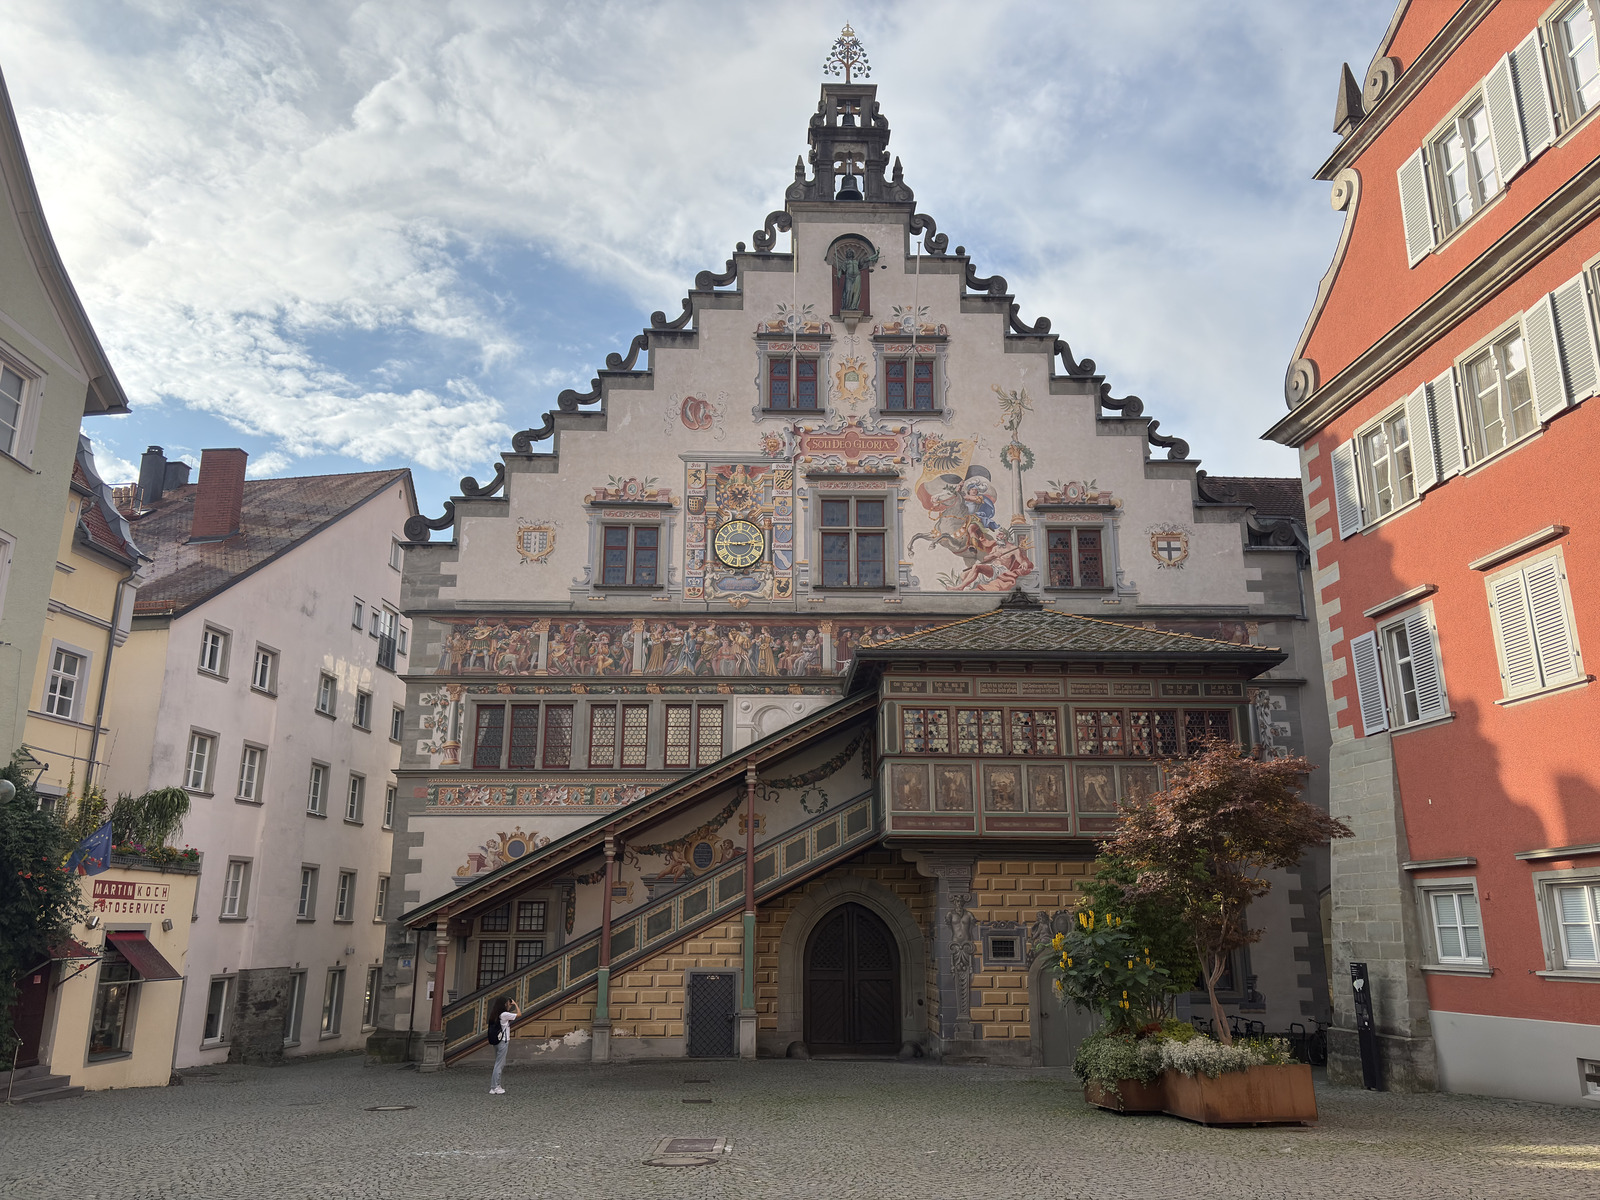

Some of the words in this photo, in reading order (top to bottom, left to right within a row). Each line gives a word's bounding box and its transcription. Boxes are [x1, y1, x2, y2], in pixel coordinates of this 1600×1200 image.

[812, 439, 831, 449] SOLI
[833, 440, 851, 449] DEO
[853, 439, 890, 450] GLORIA
[94, 883, 134, 896] MARTIN
[137, 885, 168, 898] KOCH
[92, 900, 166, 914] FOTOSERVICE
